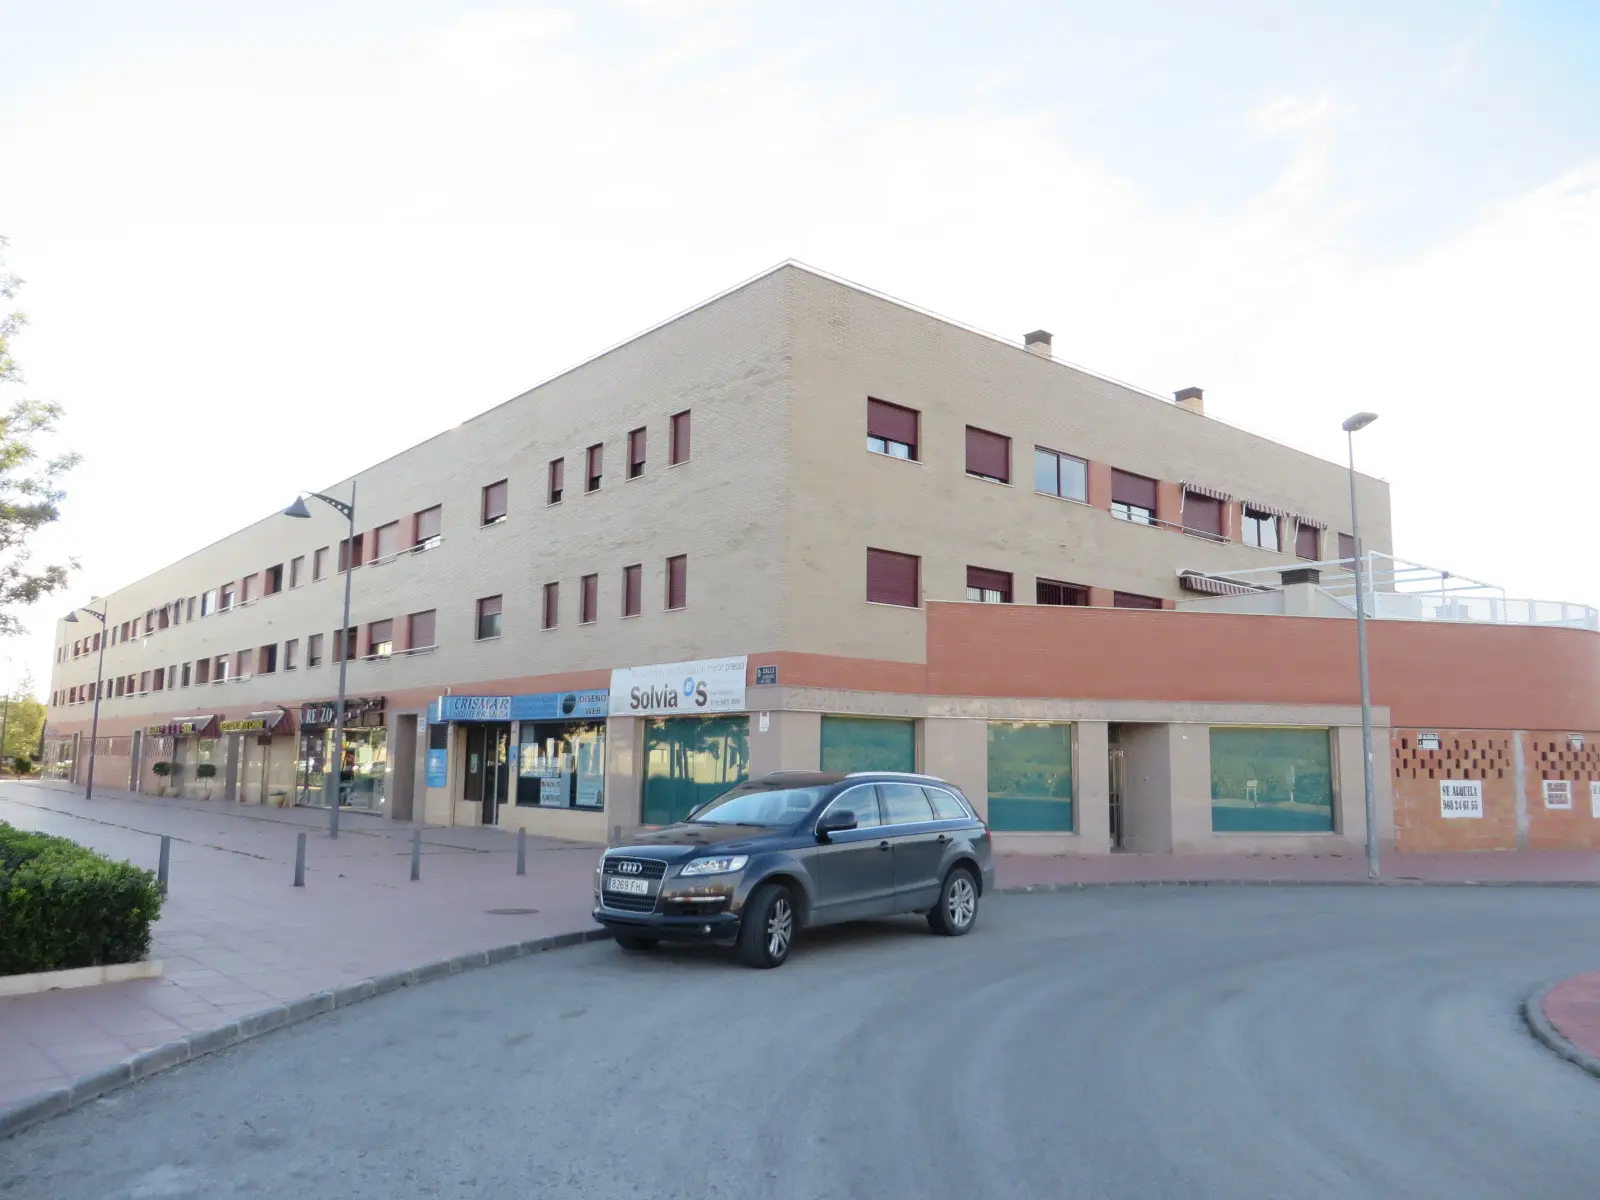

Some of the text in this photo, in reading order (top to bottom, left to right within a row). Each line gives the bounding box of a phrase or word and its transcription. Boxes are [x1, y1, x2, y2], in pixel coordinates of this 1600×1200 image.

[725, 661, 745, 673] precio
[630, 683, 678, 709] Solvia
[454, 697, 509, 710] CRISMAR
[585, 706, 601, 715] WEB
[1442, 785, 1478, 797] SE ALQUILA
[1443, 799, 1454, 811] 968
[1471, 801, 1479, 811] 55
[611, 879, 646, 893] 8269 FHL
